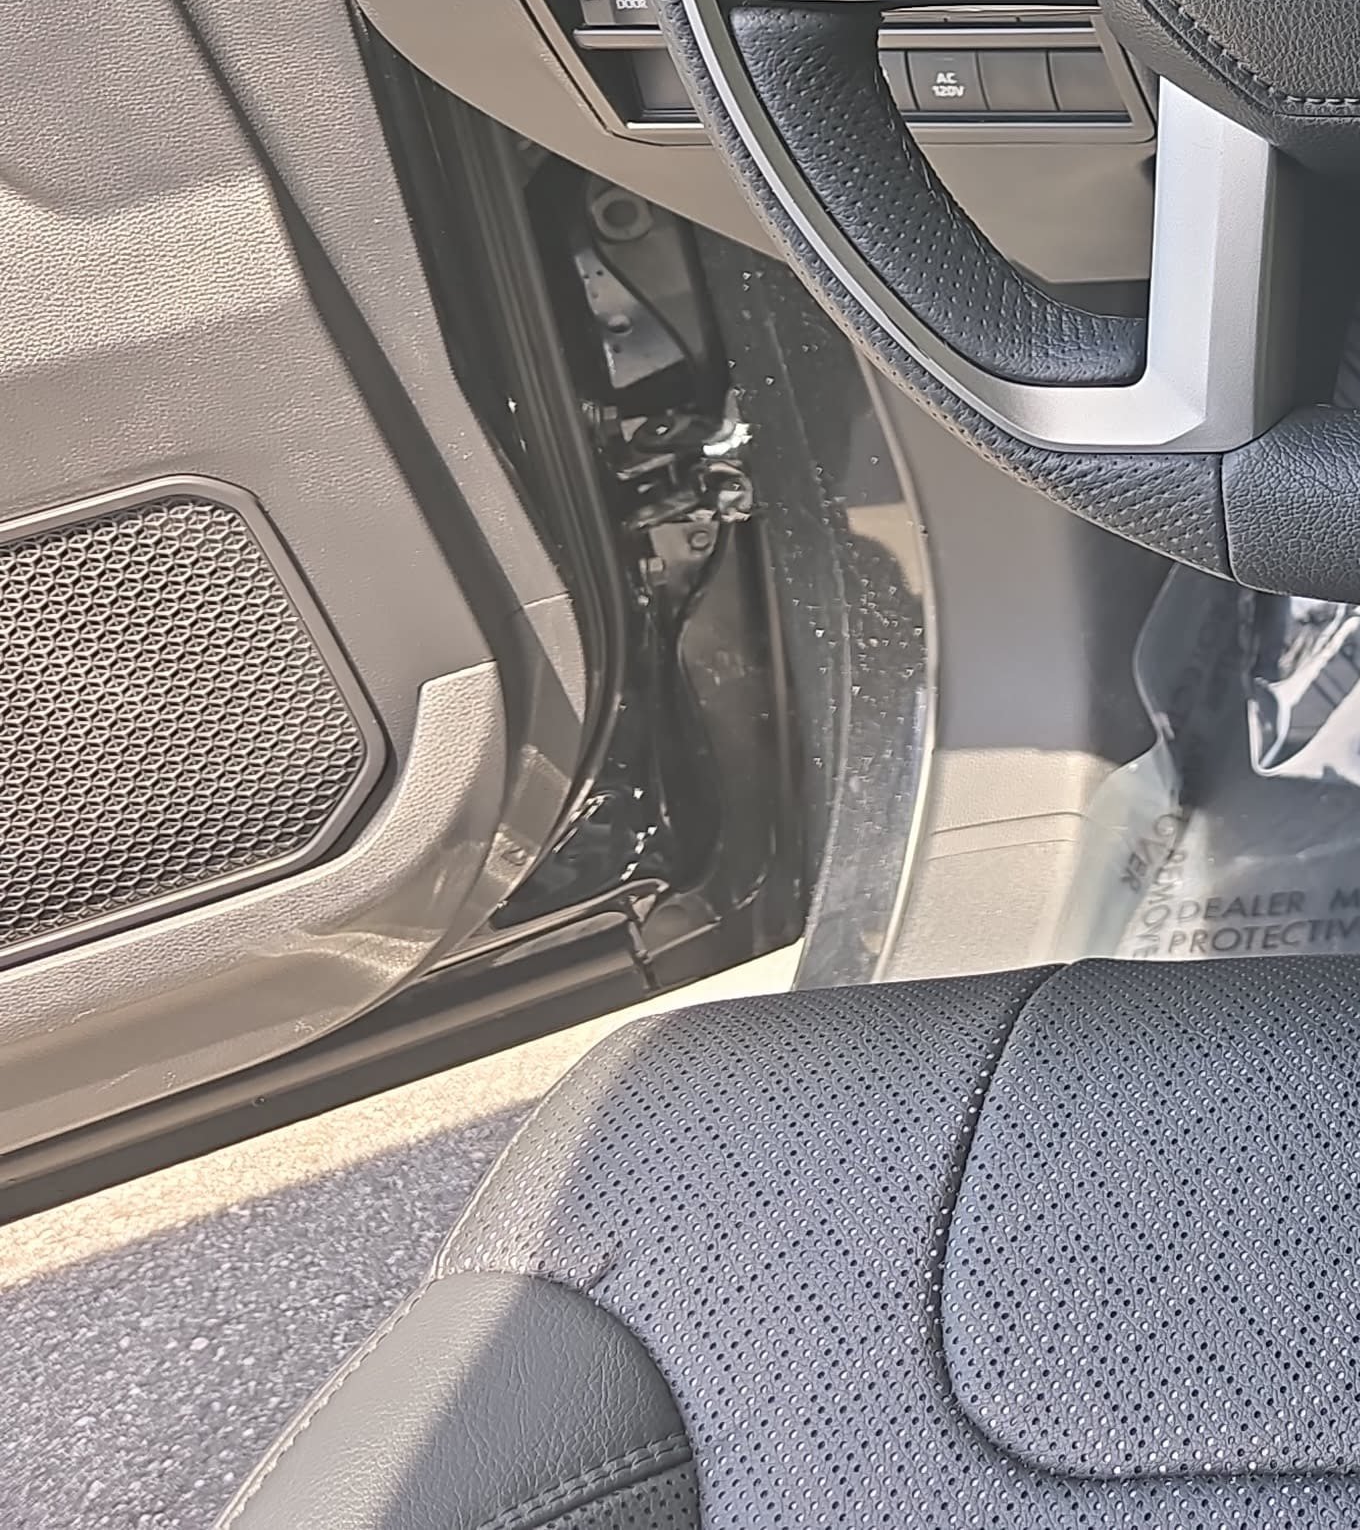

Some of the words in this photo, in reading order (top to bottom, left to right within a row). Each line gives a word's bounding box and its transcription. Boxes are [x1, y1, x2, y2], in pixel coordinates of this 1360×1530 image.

[936, 72, 957, 85] AC
[932, 85, 965, 98] 120V
[1172, 890, 1306, 924] DEALER
